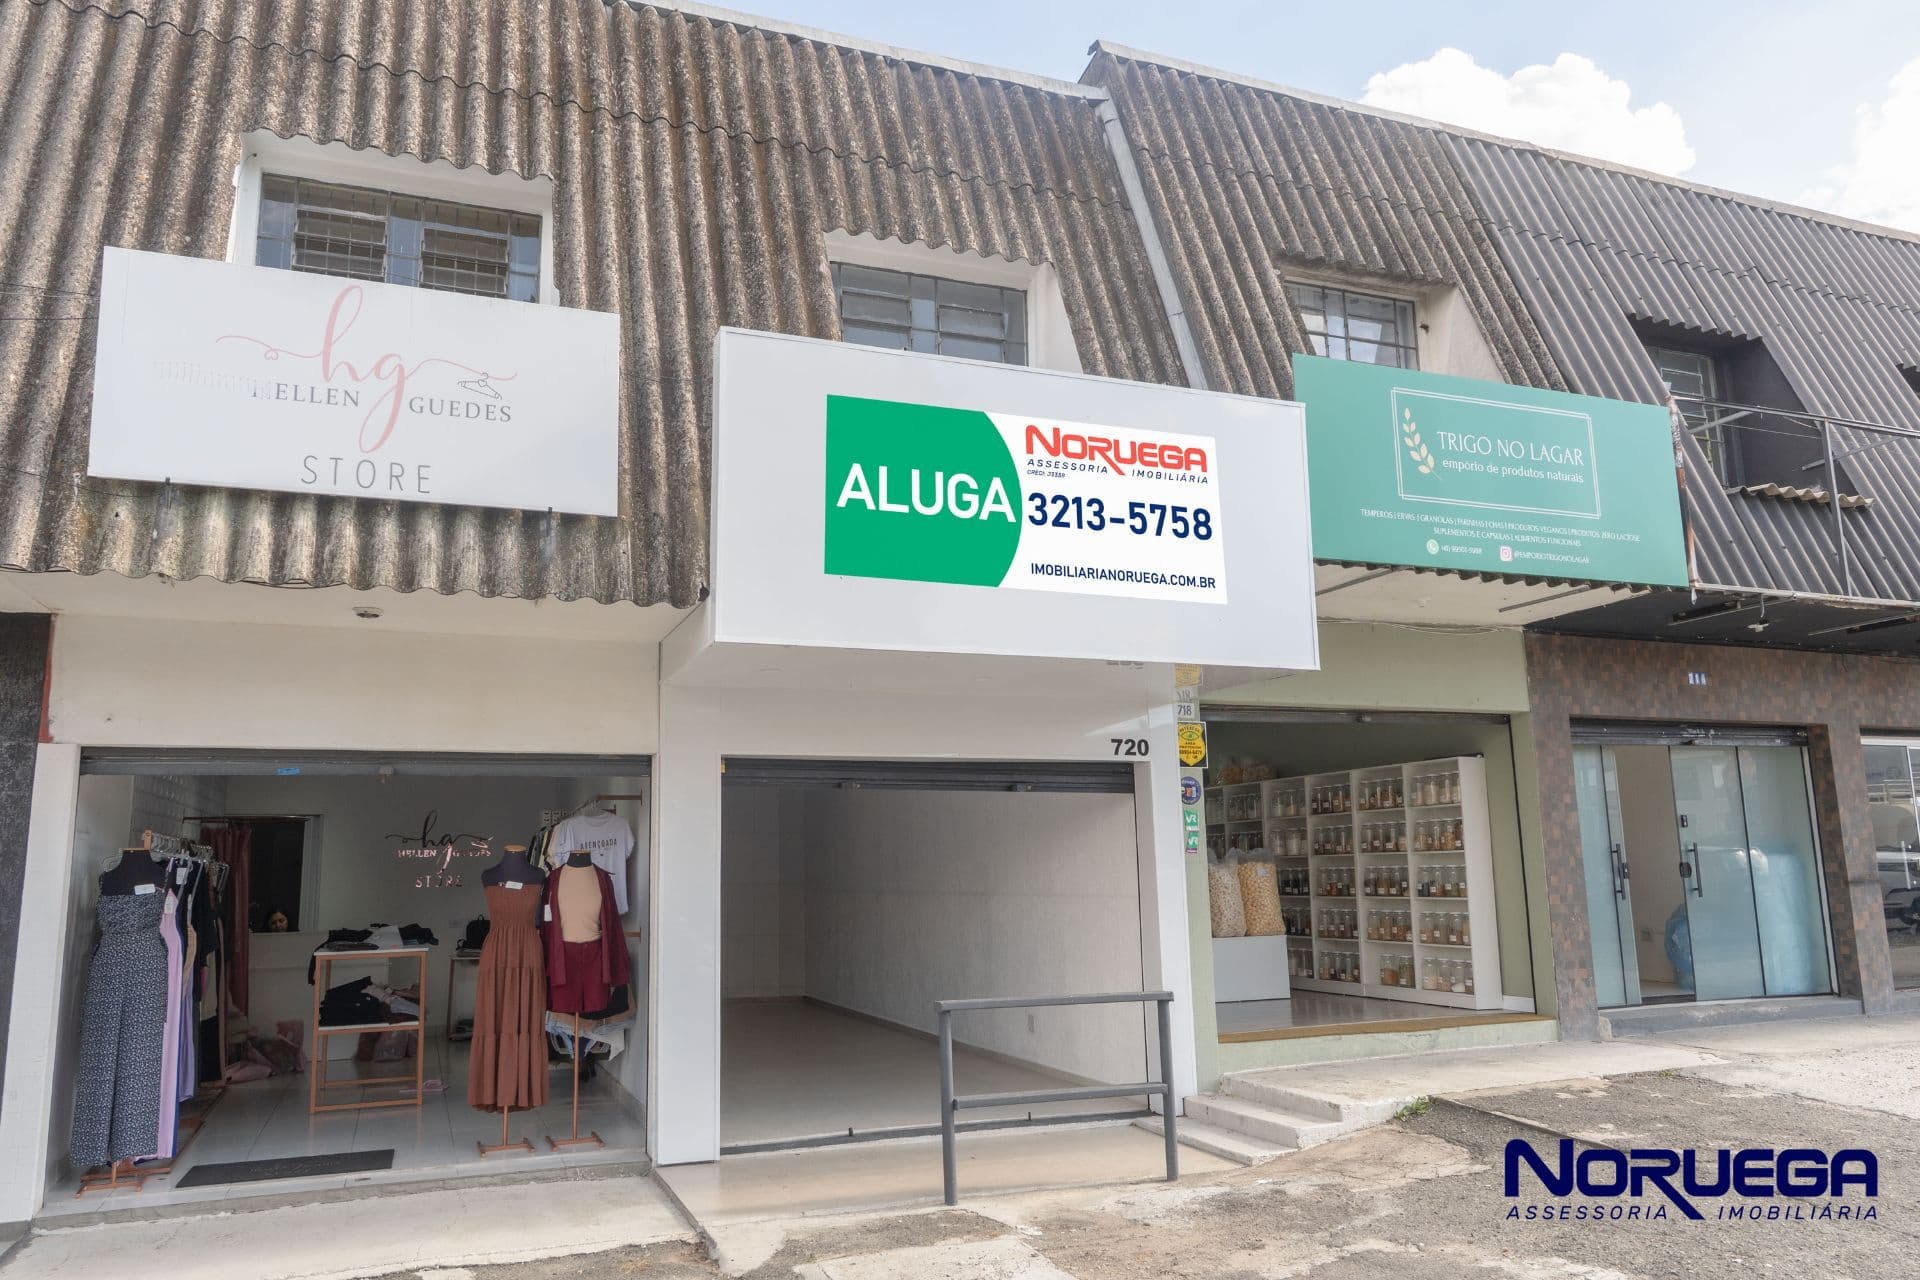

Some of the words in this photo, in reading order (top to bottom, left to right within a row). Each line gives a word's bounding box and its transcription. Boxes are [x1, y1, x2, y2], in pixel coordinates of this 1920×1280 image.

[408, 396, 512, 422] GUEDES
[1025, 424, 1207, 476] NORUEGA
[1436, 431, 1492, 455] TRIGO
[1497, 439, 1525, 459] NO
[1530, 442, 1584, 466] LAGAR
[301, 454, 432, 495] STORE
[1027, 458, 1109, 475] ASSESSORIA
[1131, 468, 1209, 485] IMOBILIÁRIA
[1486, 463, 1499, 474] de
[1502, 465, 1545, 479] produtos
[1547, 470, 1584, 483] naturais
[836, 463, 1016, 523] ALUGA
[1027, 492, 1213, 541] 3213-5758
[1030, 562, 1216, 589] IMOBILIARIANORUEGA.COM.BR
[1177, 704, 1192, 716] 718
[1110, 738, 1150, 756] 720
[397, 848, 437, 858] HELLEN
